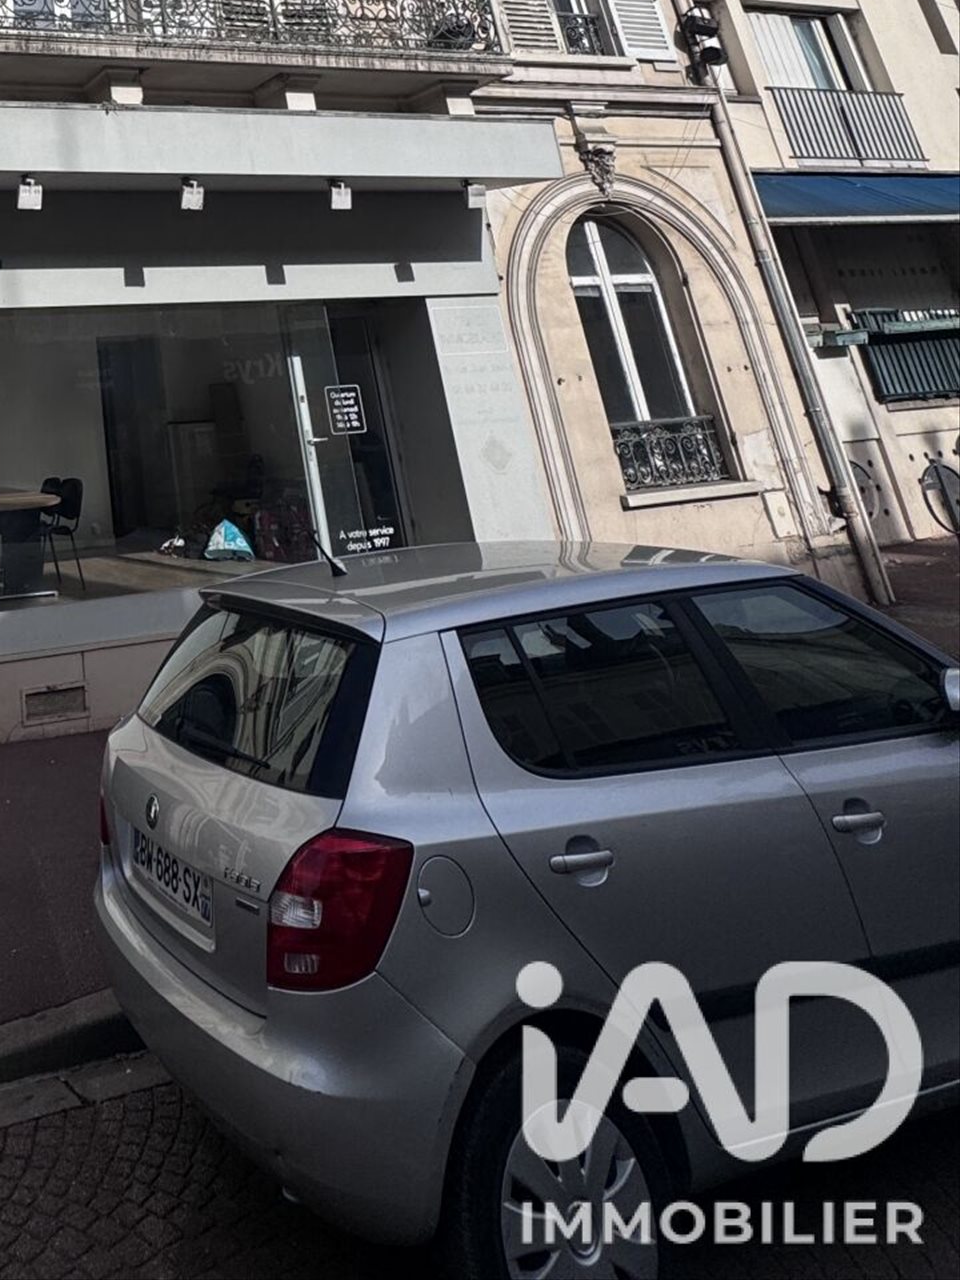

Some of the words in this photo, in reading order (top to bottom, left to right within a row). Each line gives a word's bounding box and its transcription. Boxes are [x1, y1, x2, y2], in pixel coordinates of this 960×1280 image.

[368, 526, 394, 537] service
[347, 540, 372, 553] depuis
[372, 536, 391, 548] 1997
